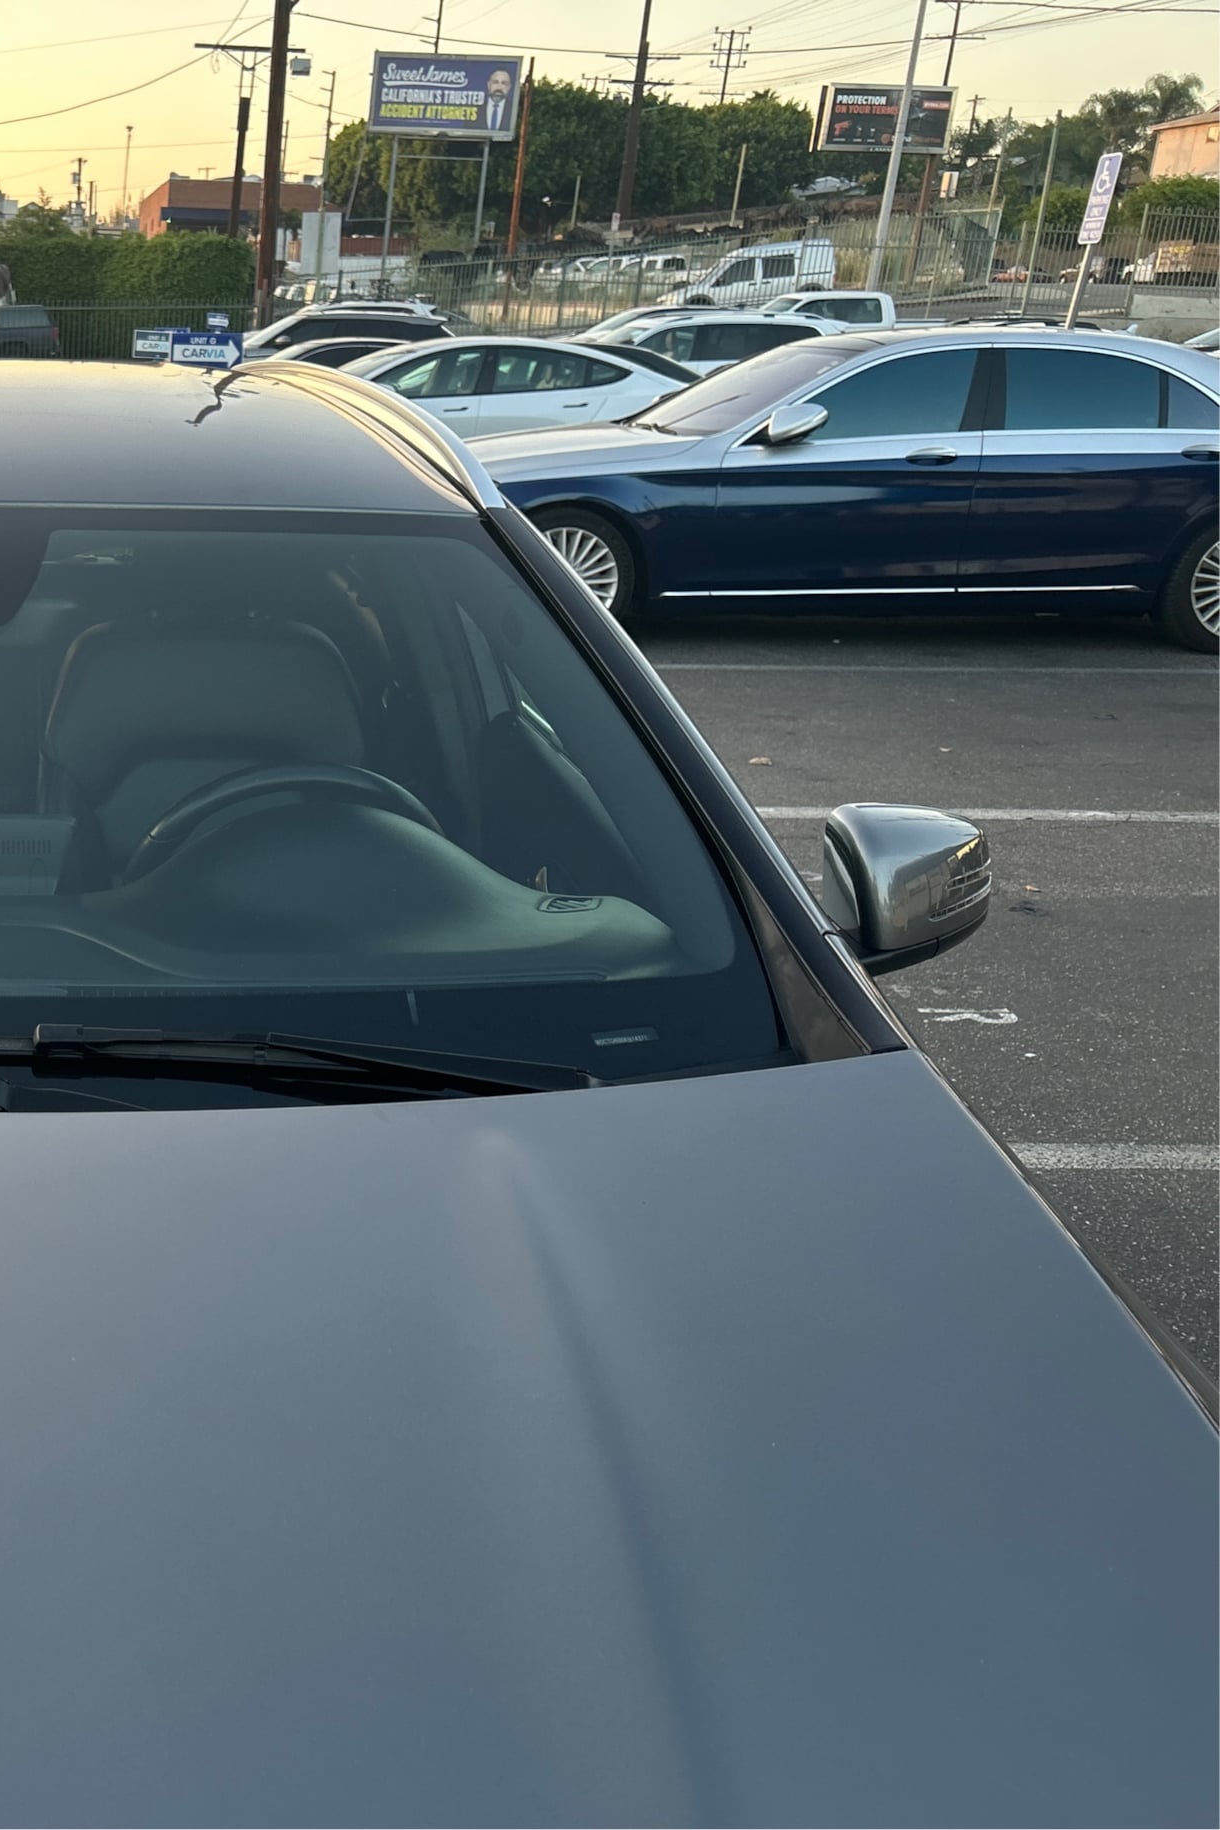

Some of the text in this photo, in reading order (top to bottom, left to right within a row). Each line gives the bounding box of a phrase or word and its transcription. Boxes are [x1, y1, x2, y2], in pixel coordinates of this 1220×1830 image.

[381, 88, 485, 105] CALIFORNIA'S TRUSTED
[836, 95, 887, 105] PROTECTION
[380, 104, 478, 121] ACCIDENT ATTORNEYS
[835, 105, 848, 114] ON
[848, 105, 871, 114] YOUR
[190, 337, 208, 345] UNIT
[182, 348, 227, 359] CARVIA
